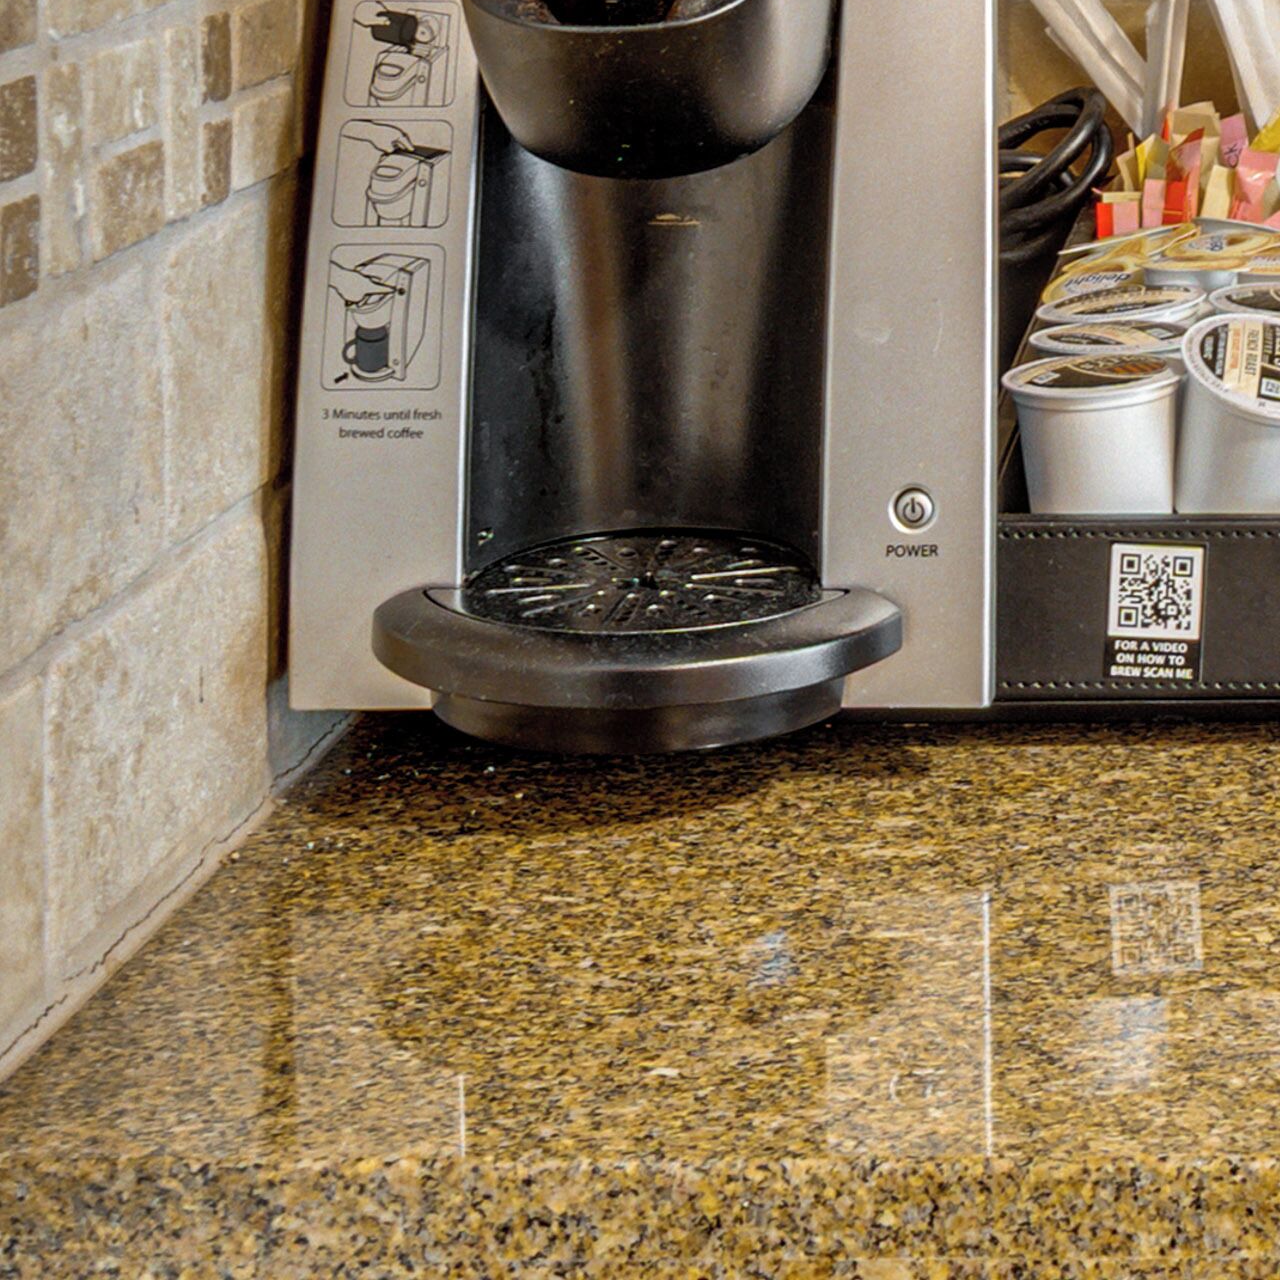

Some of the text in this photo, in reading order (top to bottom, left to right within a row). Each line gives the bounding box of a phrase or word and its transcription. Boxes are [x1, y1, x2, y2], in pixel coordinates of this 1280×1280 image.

[1245, 352, 1259, 376] ROAST
[321, 407, 443, 421] 3 Minutes until fresh
[338, 425, 425, 439] brewed coffee
[885, 544, 939, 558] POWER
[1114, 640, 1188, 654] FOR A VIDEO
[1116, 652, 1186, 666] ON HOW TO
[1110, 664, 1194, 680] BREW SCAN ME
